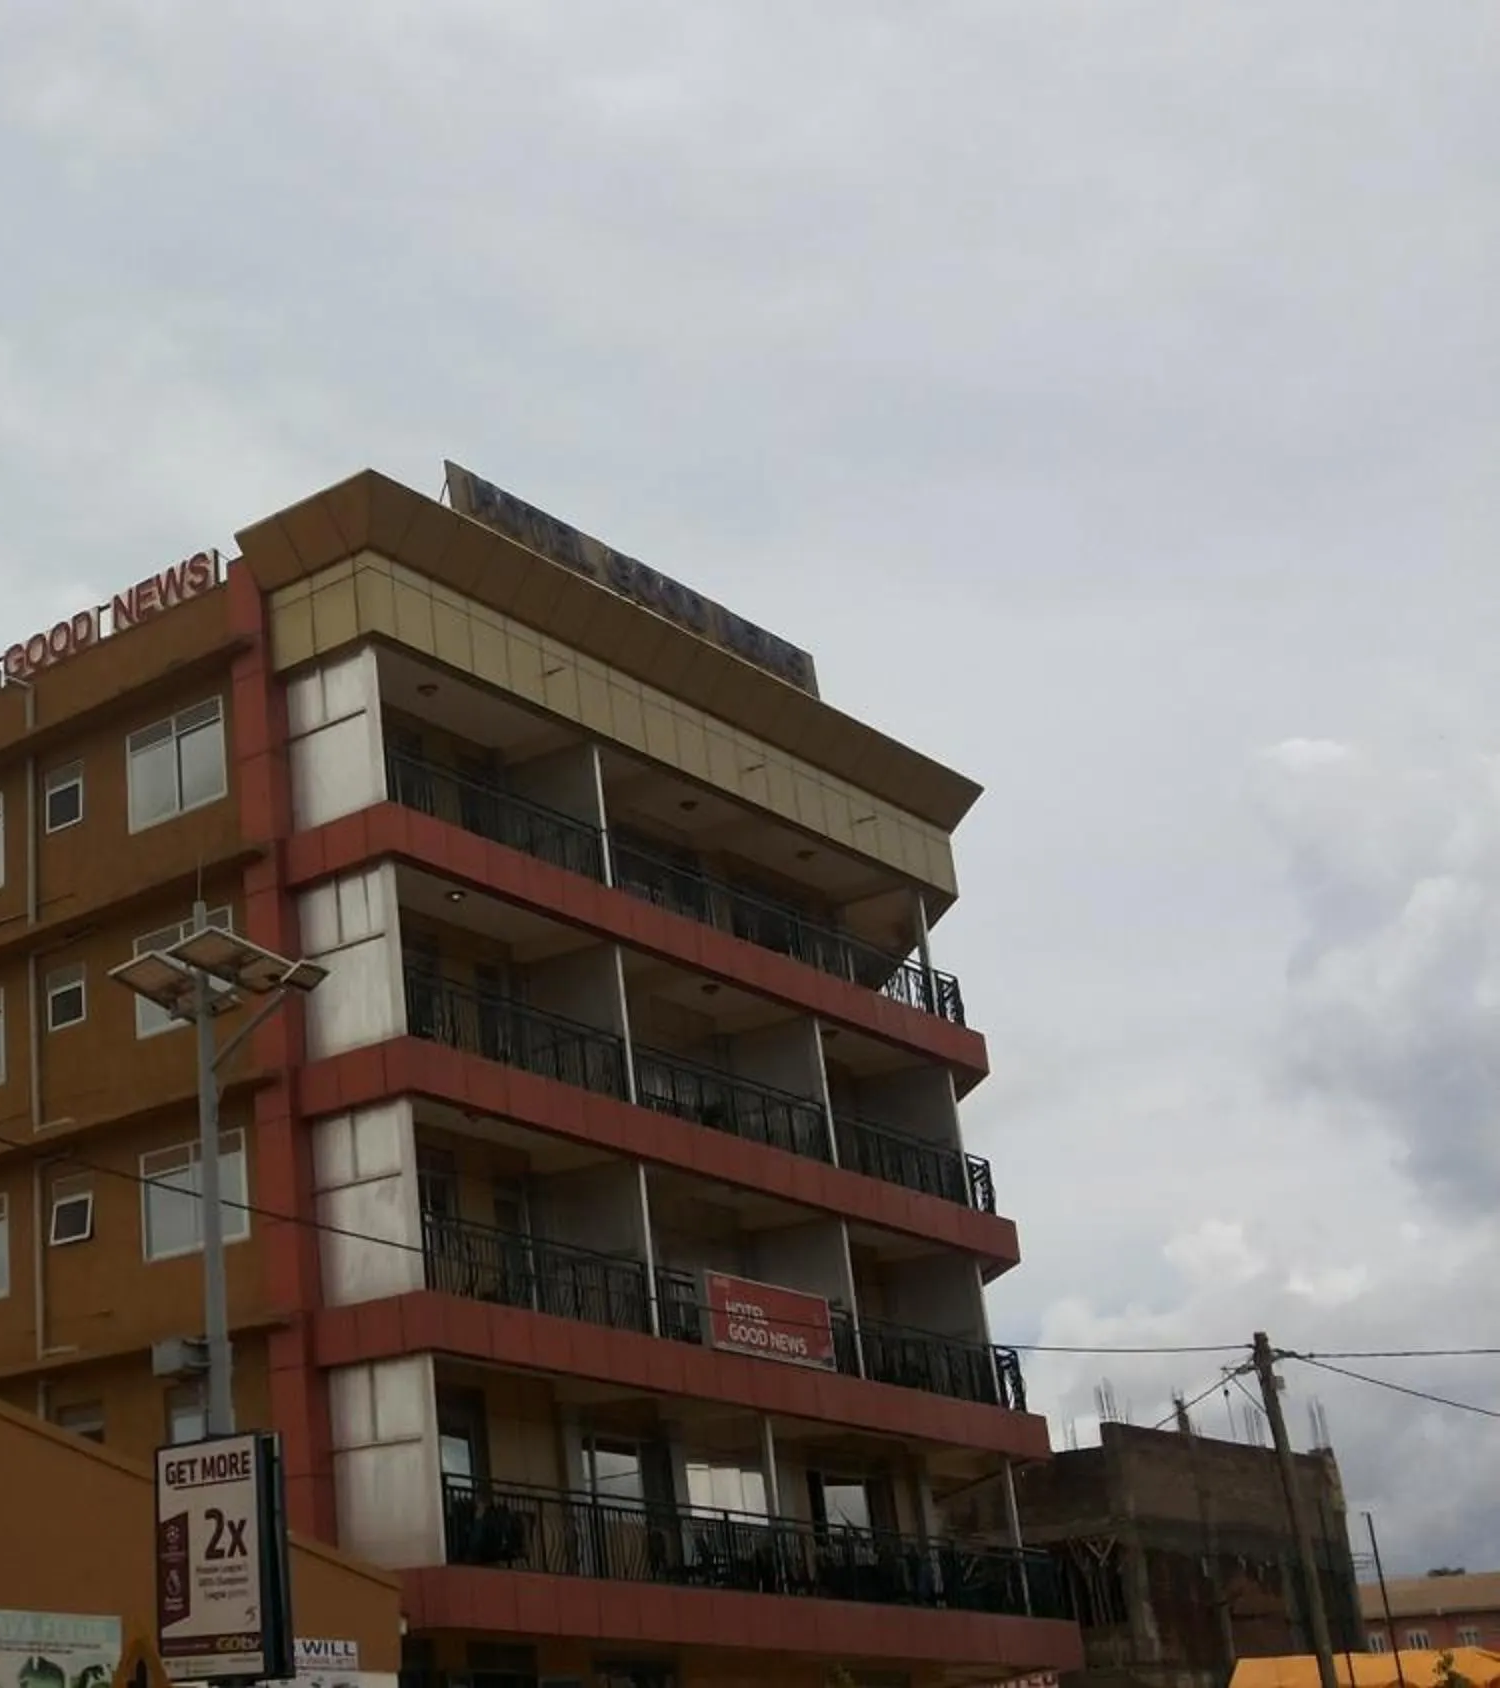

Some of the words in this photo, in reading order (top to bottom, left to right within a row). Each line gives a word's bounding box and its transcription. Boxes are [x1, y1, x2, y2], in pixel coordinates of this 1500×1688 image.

[3, 607, 100, 678] GOOD
[112, 550, 213, 629] NEWS
[726, 1299, 769, 1325] HOTEL
[729, 1323, 769, 1346] GOOD
[769, 1331, 808, 1356] NEWS
[165, 1458, 197, 1486] GET
[201, 1450, 251, 1479] MORE
[204, 1507, 248, 1561] 2x
[301, 1639, 356, 1657] WILL
